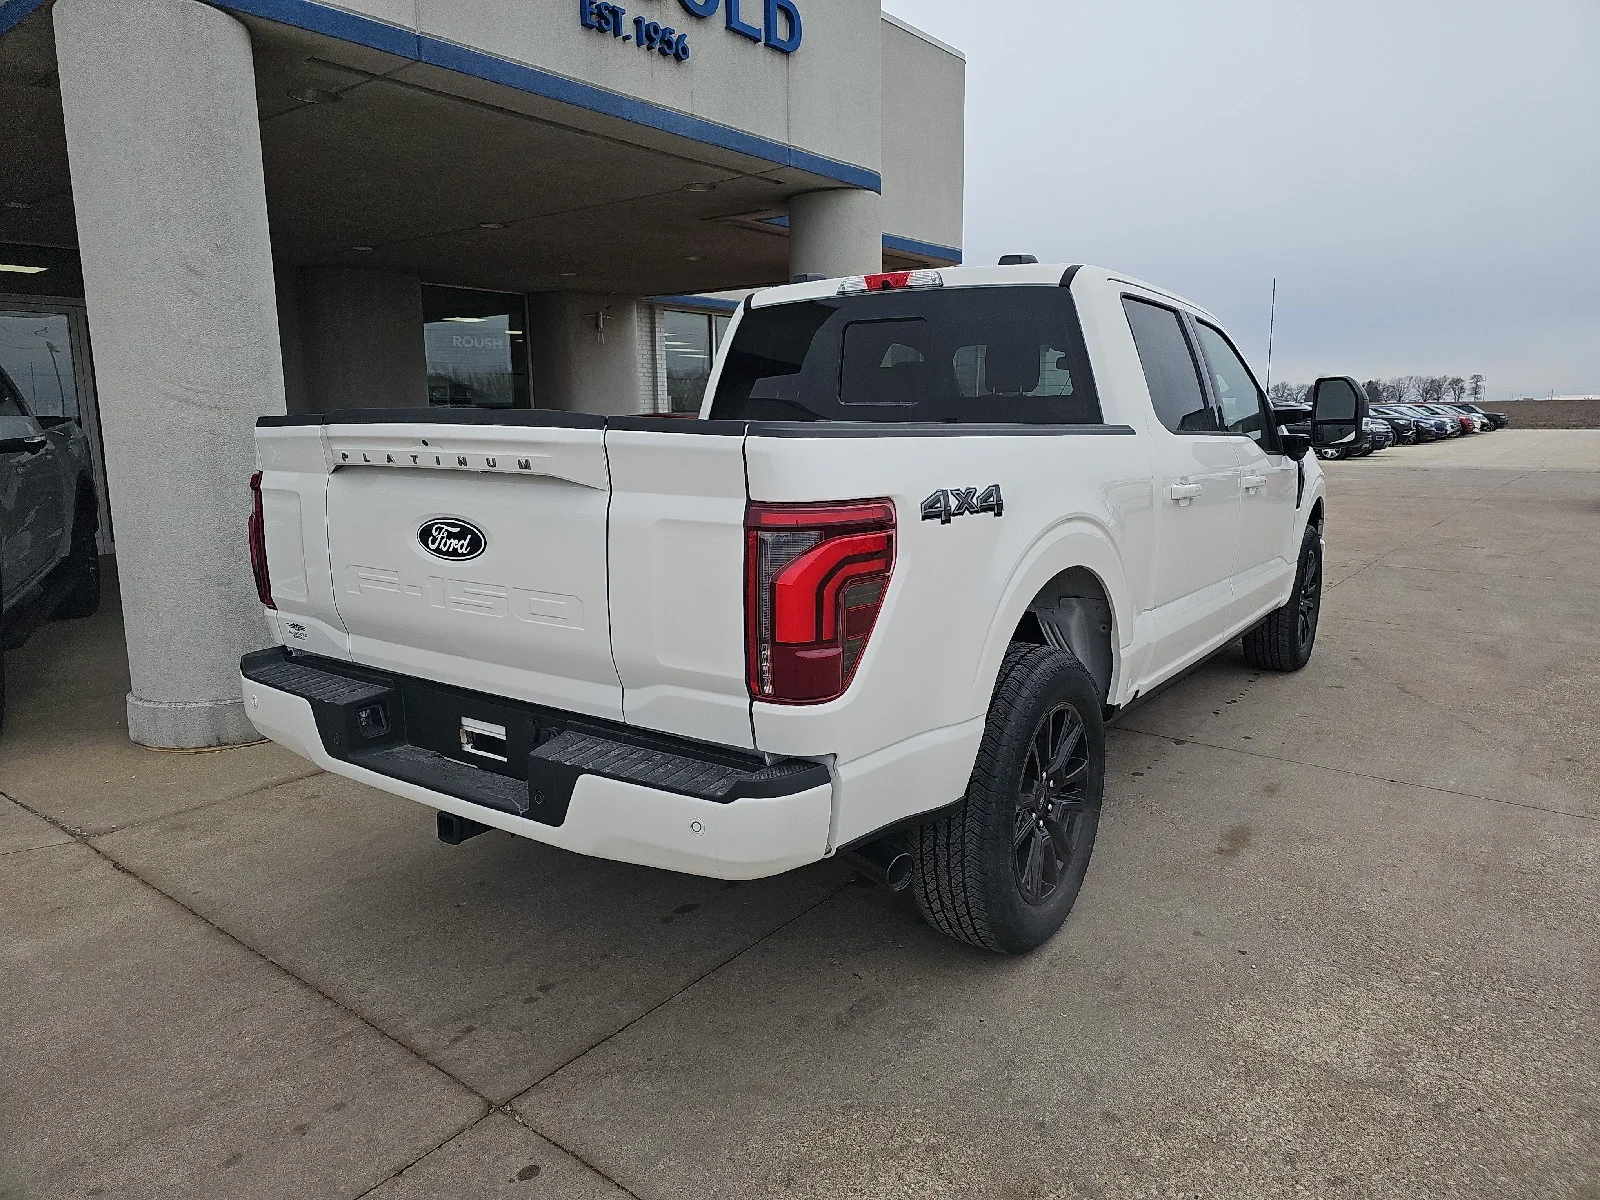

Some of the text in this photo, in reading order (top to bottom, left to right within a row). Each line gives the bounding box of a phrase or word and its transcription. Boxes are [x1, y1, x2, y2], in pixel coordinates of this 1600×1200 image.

[341, 452, 532, 470] PLATINUM
[428, 523, 473, 554] Ford
[345, 563, 586, 631] F-150
